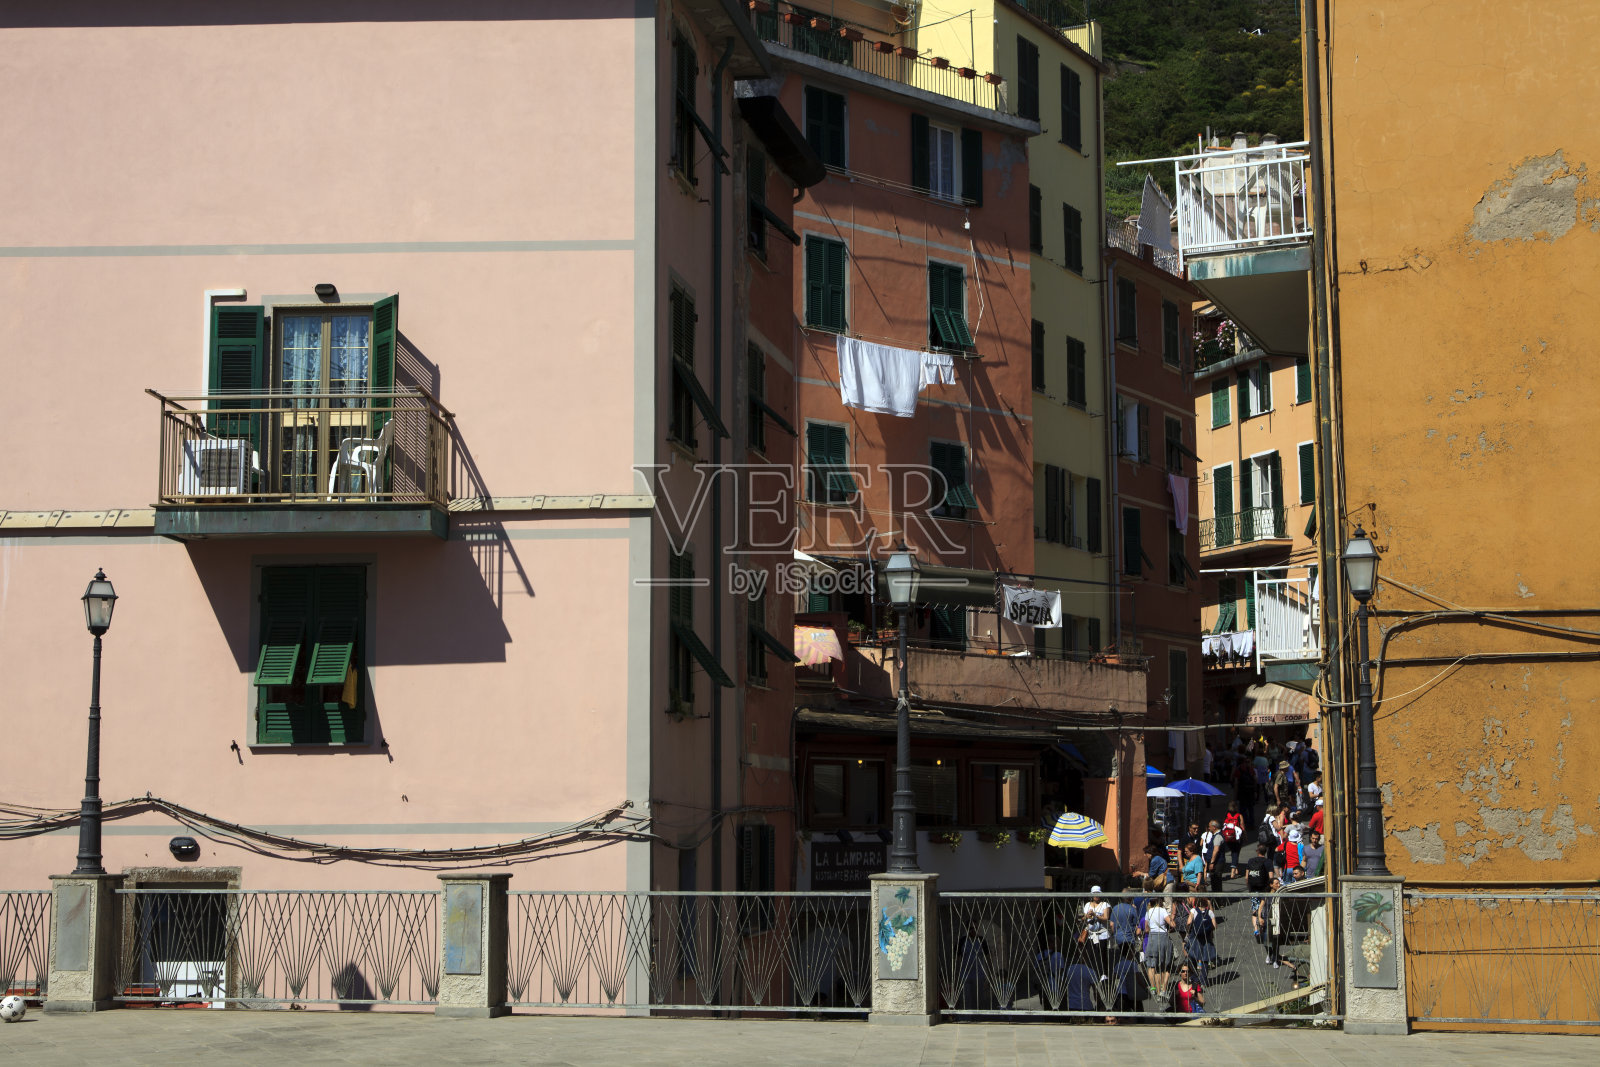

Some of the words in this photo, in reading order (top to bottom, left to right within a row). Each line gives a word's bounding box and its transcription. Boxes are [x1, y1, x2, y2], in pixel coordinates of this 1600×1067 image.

[1010, 601, 1054, 625] SPEZIA
[815, 851, 829, 867] LA
[836, 851, 882, 867] LAMPARA
